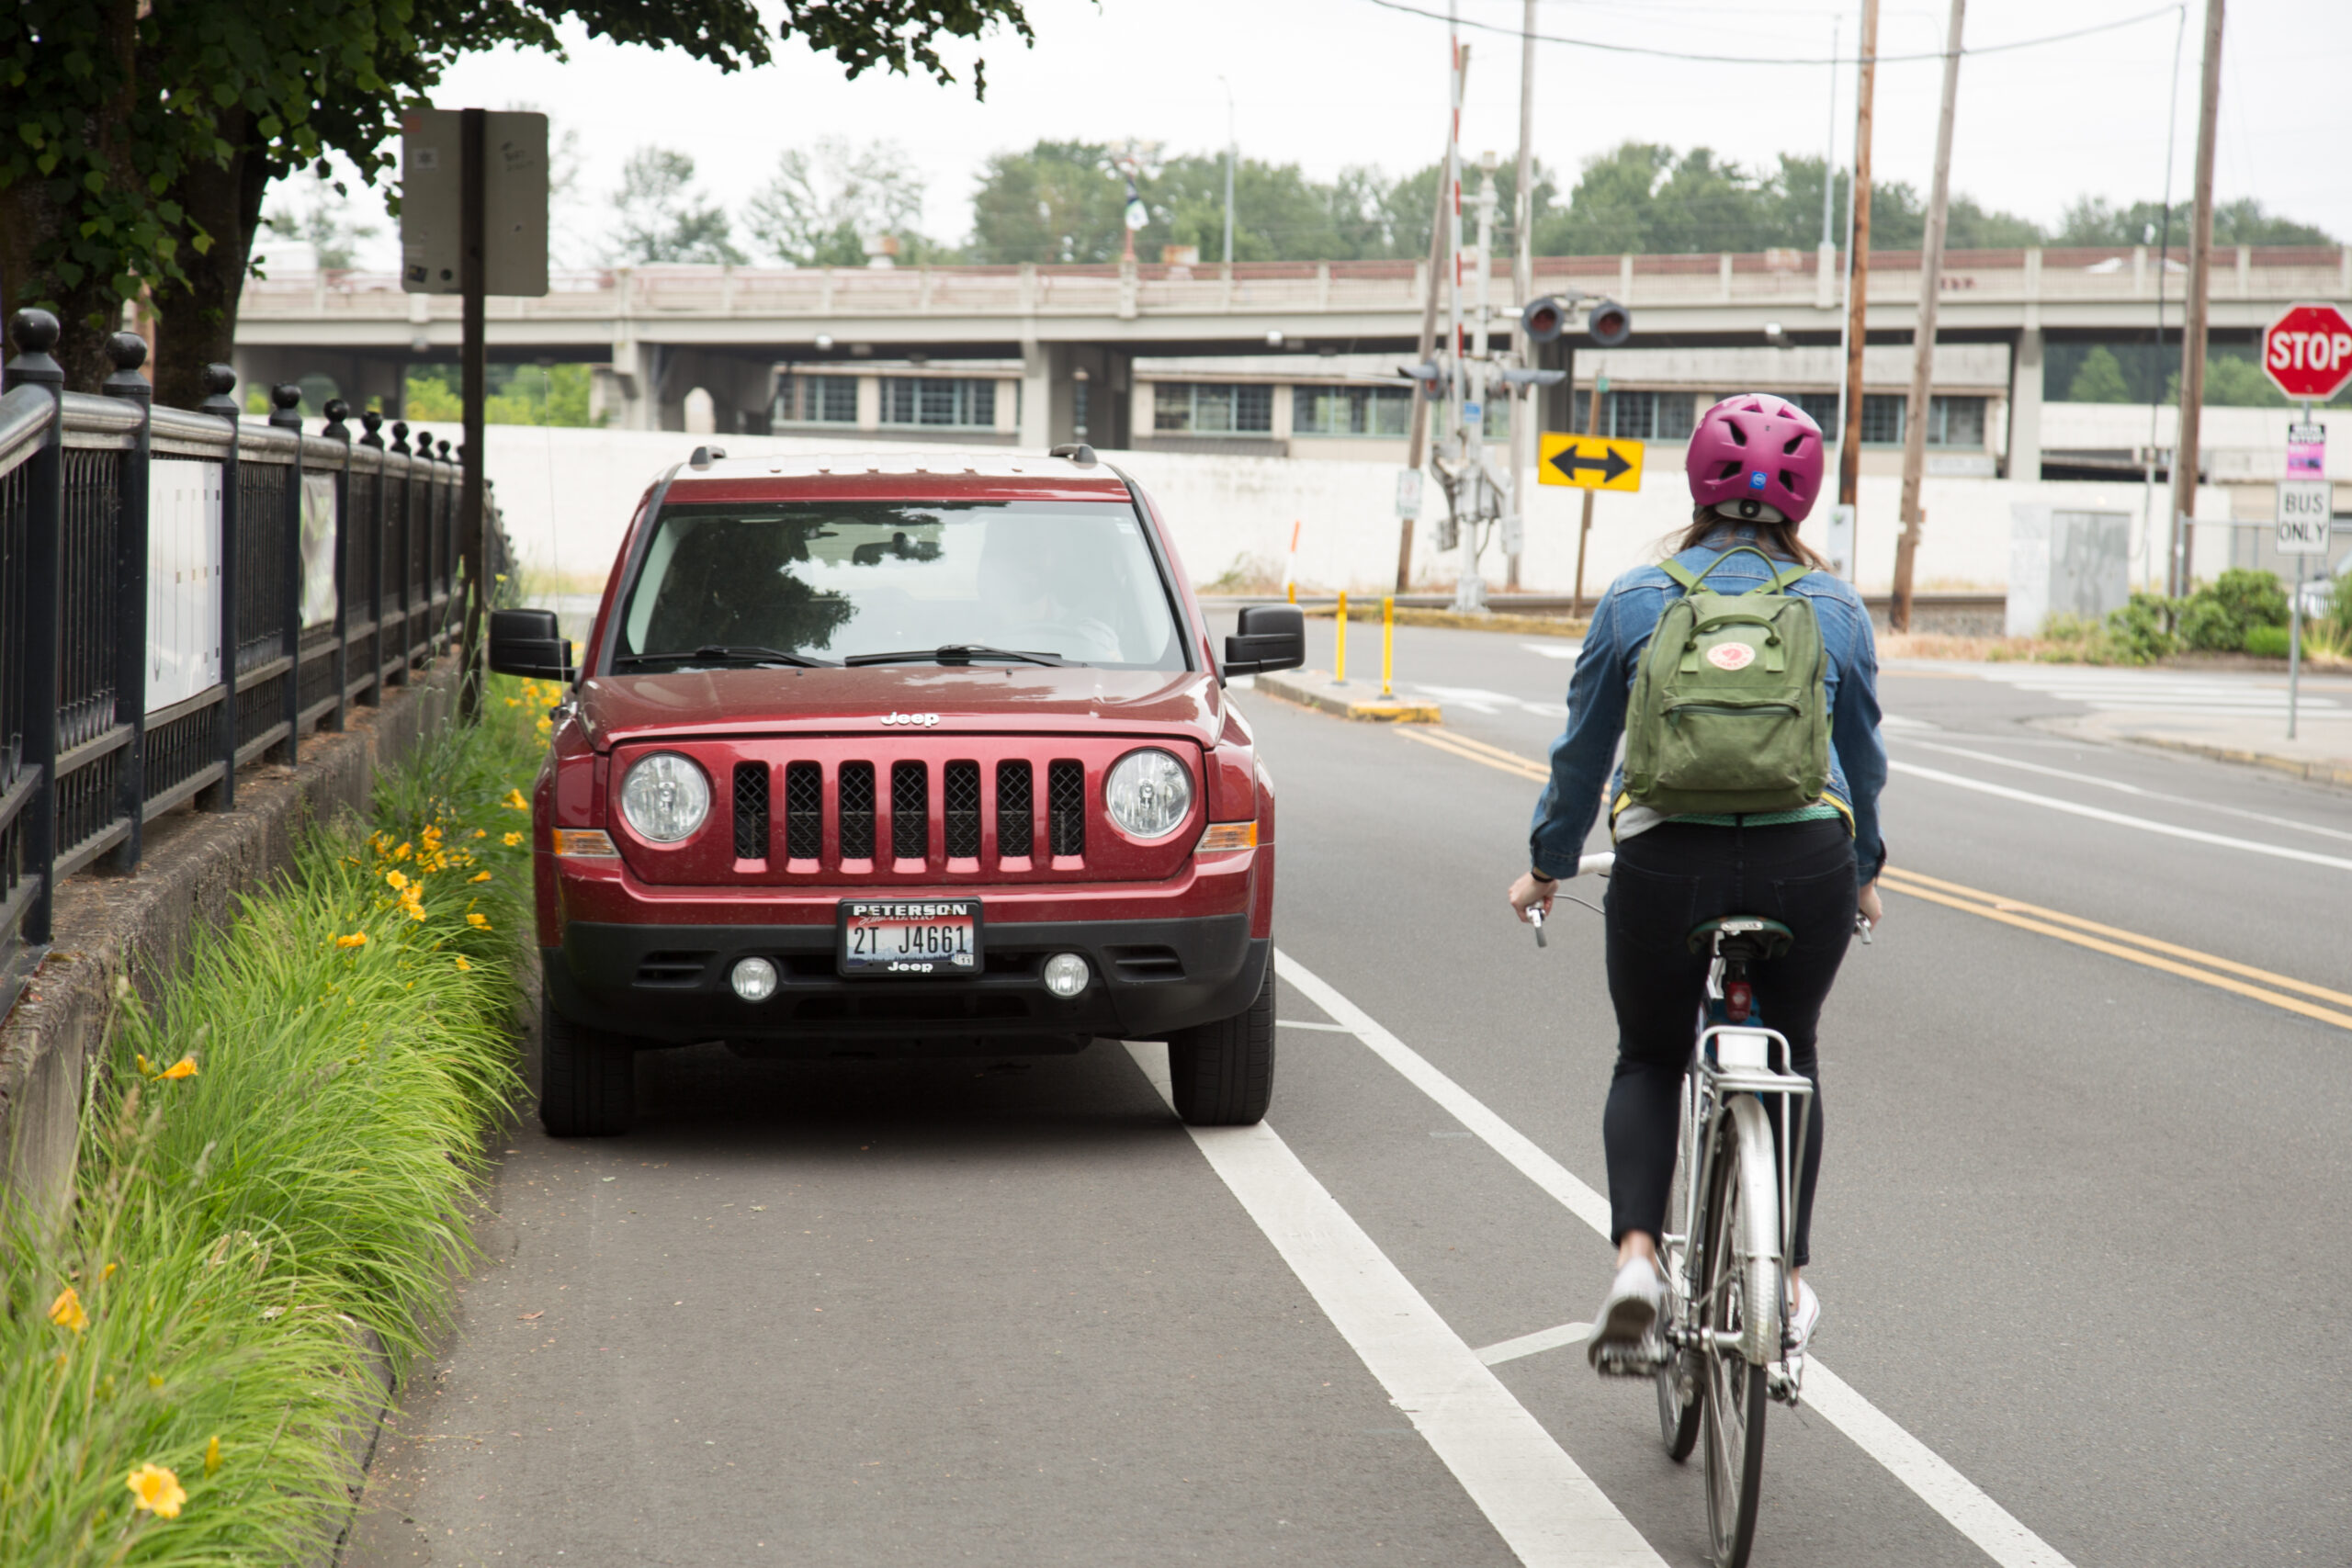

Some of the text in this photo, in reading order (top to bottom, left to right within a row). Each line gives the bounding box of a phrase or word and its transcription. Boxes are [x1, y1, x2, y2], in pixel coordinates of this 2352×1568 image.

[2269, 332, 2352, 371] STOP
[2285, 492, 2324, 513] BUS
[2279, 522, 2327, 542] ONLY
[880, 711, 940, 728] Jeep
[854, 904, 967, 916] PETERSON
[854, 925, 967, 954] 2T J4661
[888, 962, 933, 973] Jeep
